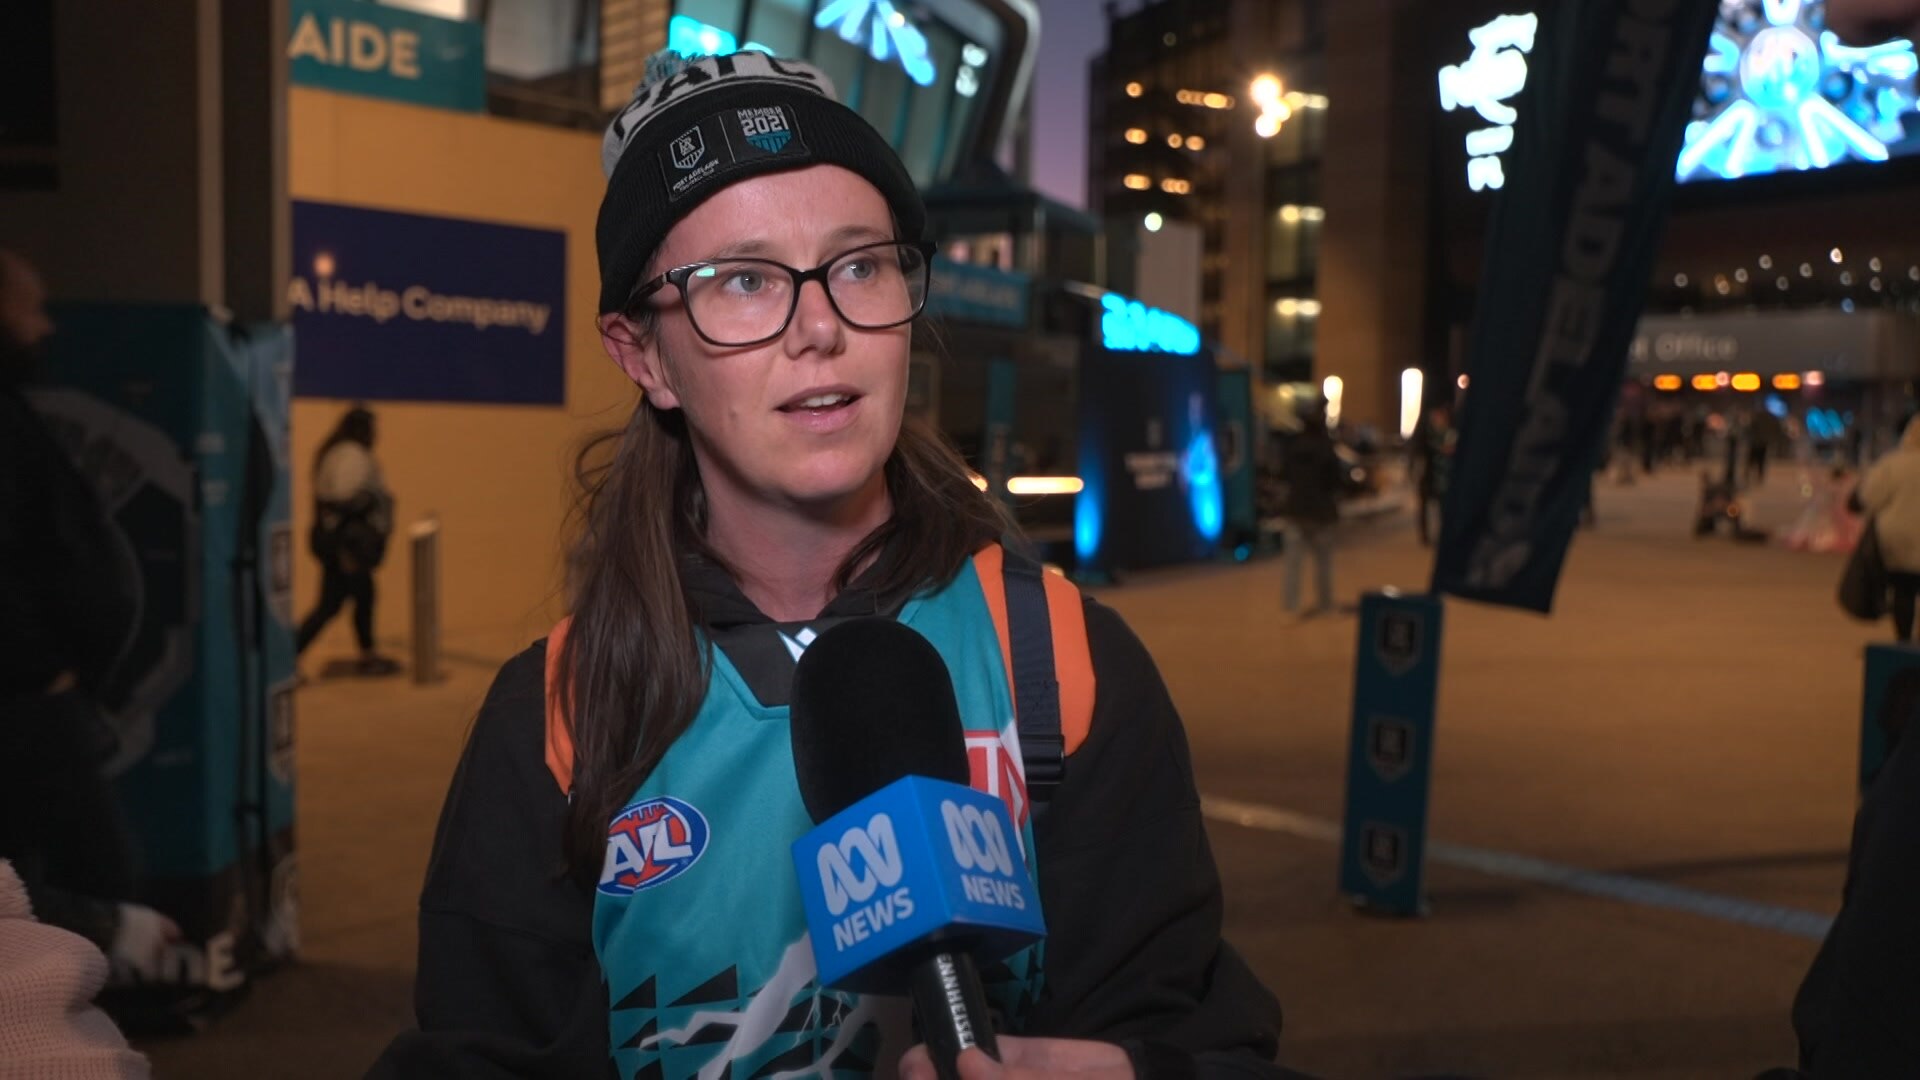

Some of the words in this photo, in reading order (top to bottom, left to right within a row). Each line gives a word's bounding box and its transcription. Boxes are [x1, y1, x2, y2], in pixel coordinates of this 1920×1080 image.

[288, 12, 421, 80] AIDE
[737, 105, 783, 121] MEMBER
[741, 114, 789, 137] 2021
[317, 279, 400, 324] Help
[402, 285, 550, 334] Company
[960, 874, 1025, 910] NEWS
[832, 887, 914, 951] NEWS
